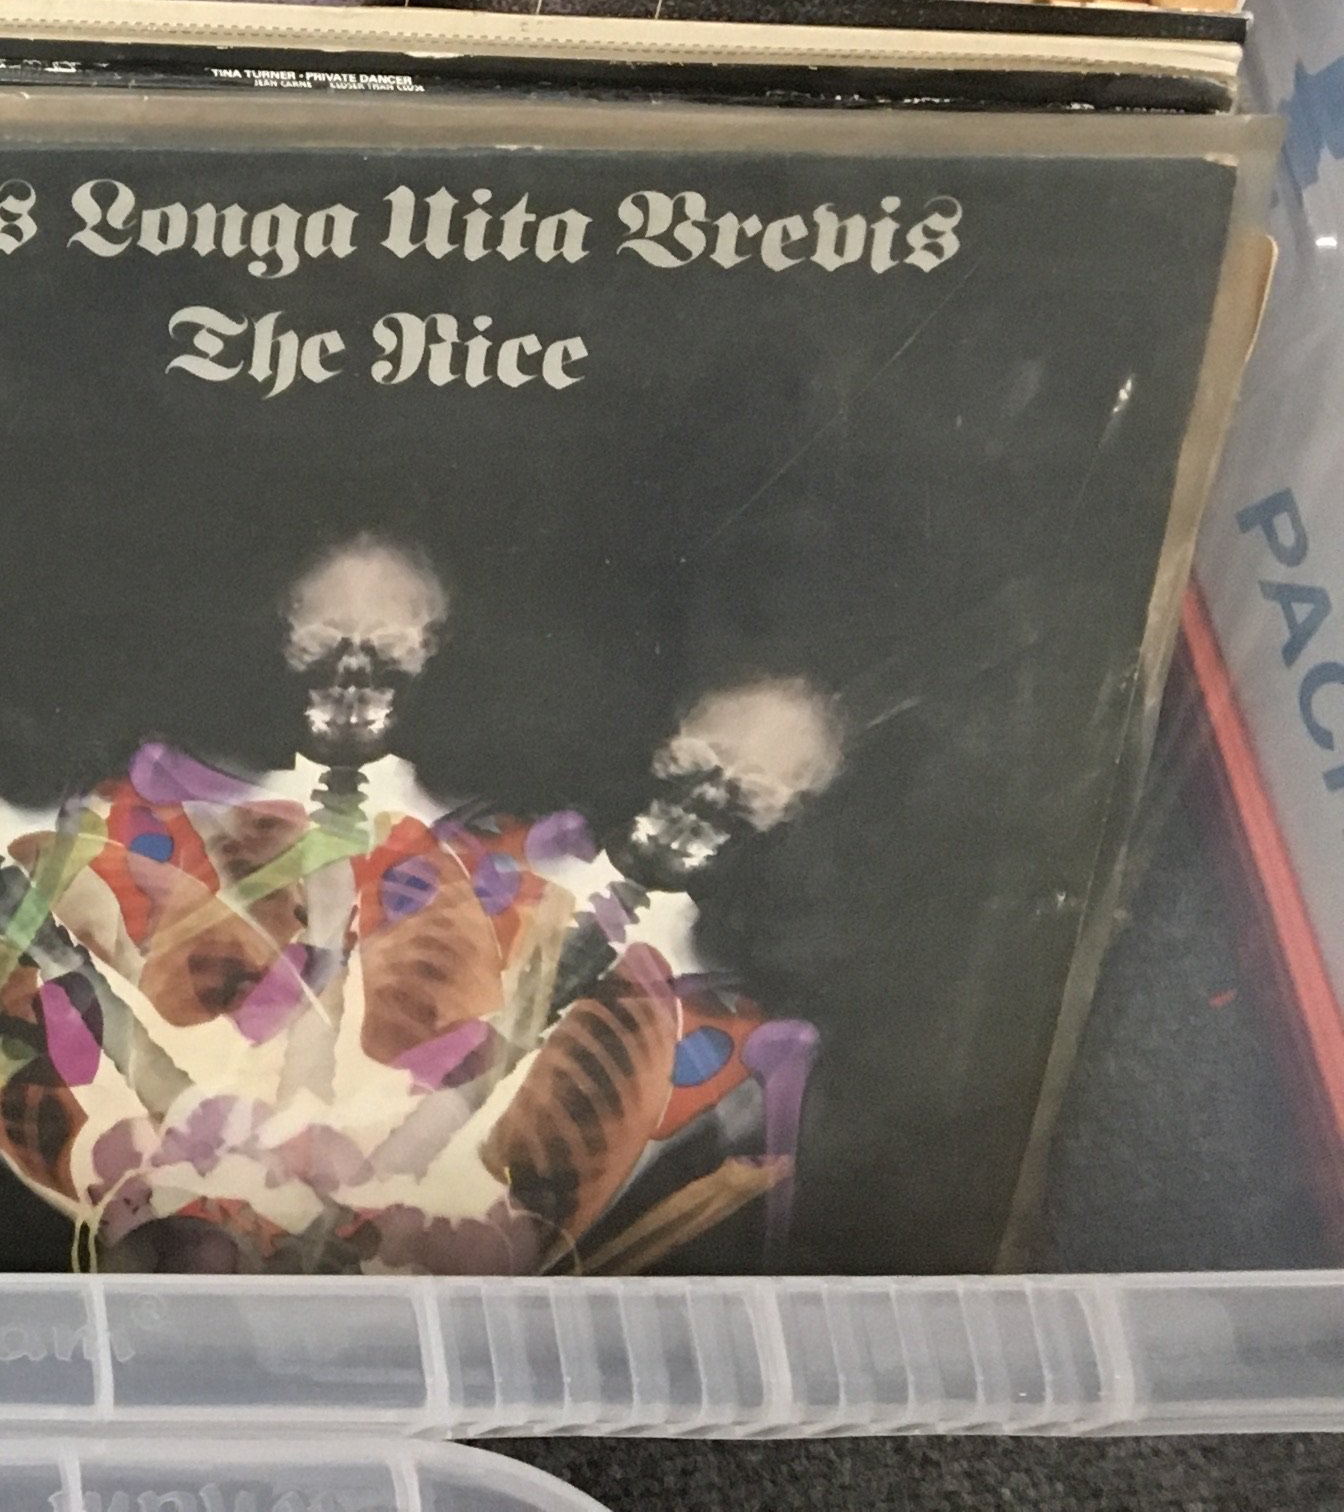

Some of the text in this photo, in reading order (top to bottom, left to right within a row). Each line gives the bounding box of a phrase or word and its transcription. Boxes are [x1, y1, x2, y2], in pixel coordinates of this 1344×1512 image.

[211, 69, 413, 85] TINA TURNER PRIVATE DANCER
[66, 178, 360, 280] Longa
[617, 190, 964, 273] Brevis
[165, 305, 346, 400] The
